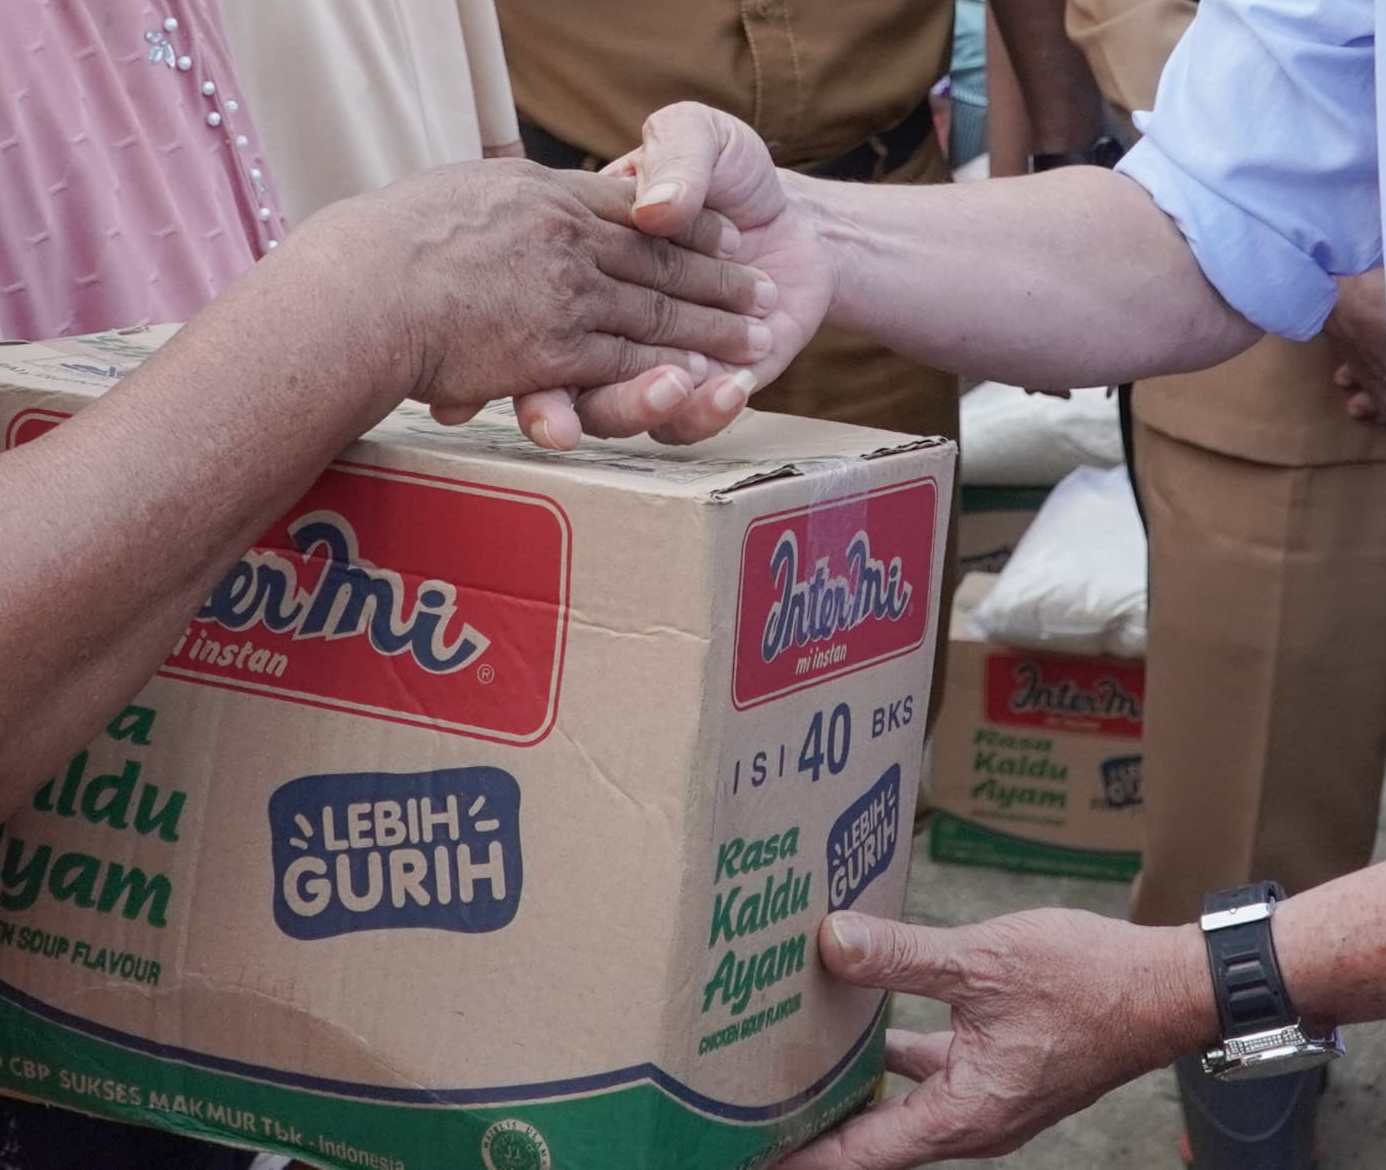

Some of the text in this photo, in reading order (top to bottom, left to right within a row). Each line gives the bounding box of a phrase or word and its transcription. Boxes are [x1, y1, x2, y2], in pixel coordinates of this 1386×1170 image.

[190, 630, 289, 678] instan
[812, 643, 848, 670] instan
[798, 702, 851, 783] 40
[871, 695, 914, 739] BKS
[973, 750, 1068, 781] Kaldu
[322, 794, 460, 851] LEBIH
[971, 778, 1067, 810] Ayam
[714, 826, 800, 885] Rasa
[844, 796, 886, 856] LEBIH
[282, 840, 506, 917] GURIH
[830, 806, 897, 907] GURIH
[709, 866, 812, 950] Kaldu
[17, 925, 70, 960] SOUP
[70, 940, 162, 986] FLAVOUR
[701, 932, 807, 1016] Ayam
[9, 1056, 51, 1082] CBP
[59, 1069, 142, 1107] SUKSES
[149, 1092, 256, 1133] MAKMUR
[262, 1114, 303, 1148] Tbk
[317, 1134, 406, 1170] Indonesia
